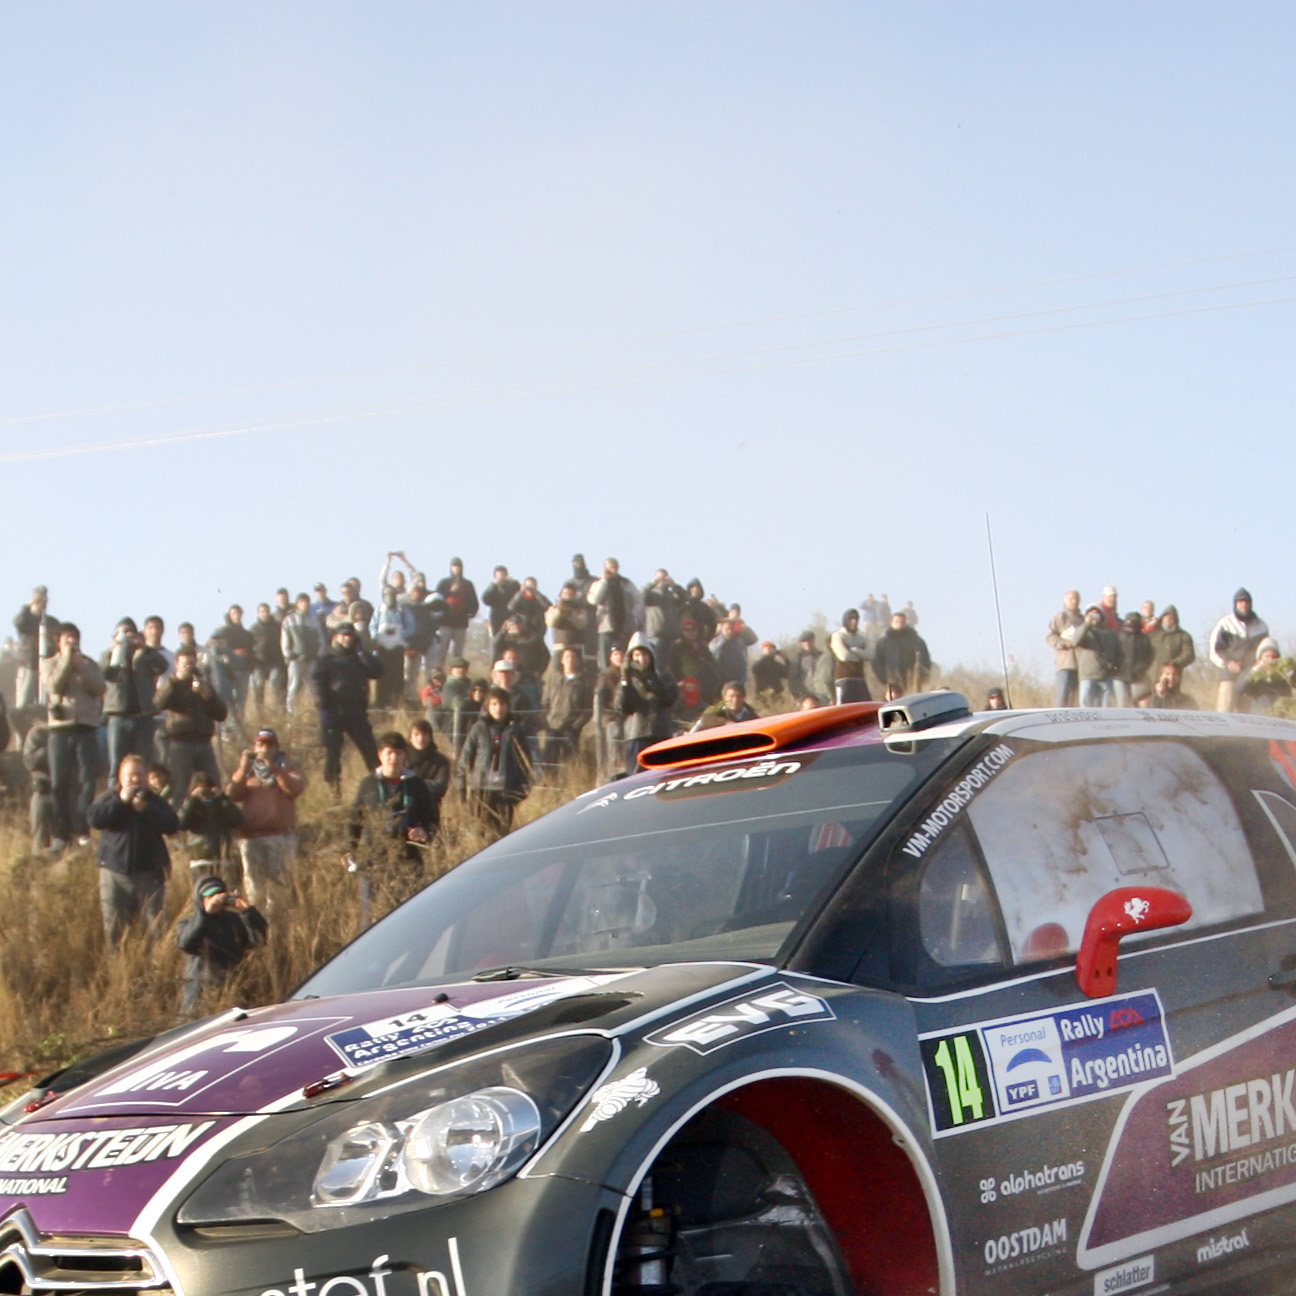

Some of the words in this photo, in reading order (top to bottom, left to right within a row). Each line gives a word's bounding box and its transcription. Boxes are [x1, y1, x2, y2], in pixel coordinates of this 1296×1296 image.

[903, 744, 1014, 859] VM-MOTORSPORT.COM
[388, 1013, 428, 1028] 14
[1000, 1026, 1047, 1047] Personal
[1060, 1013, 1104, 1042] Rally
[344, 1032, 400, 1053] Rally
[354, 1021, 472, 1060] Argentina
[934, 1035, 984, 1125] 14
[1070, 1043, 1168, 1088] Argentina
[1008, 1083, 1036, 1101] YPF
[1167, 1099, 1191, 1168] VAN
[1000, 1160, 1085, 1196] alphatrans
[984, 1217, 1068, 1265] OOSTDAM
[1197, 1226, 1251, 1263] mistral
[1104, 1263, 1152, 1293] schlatter
